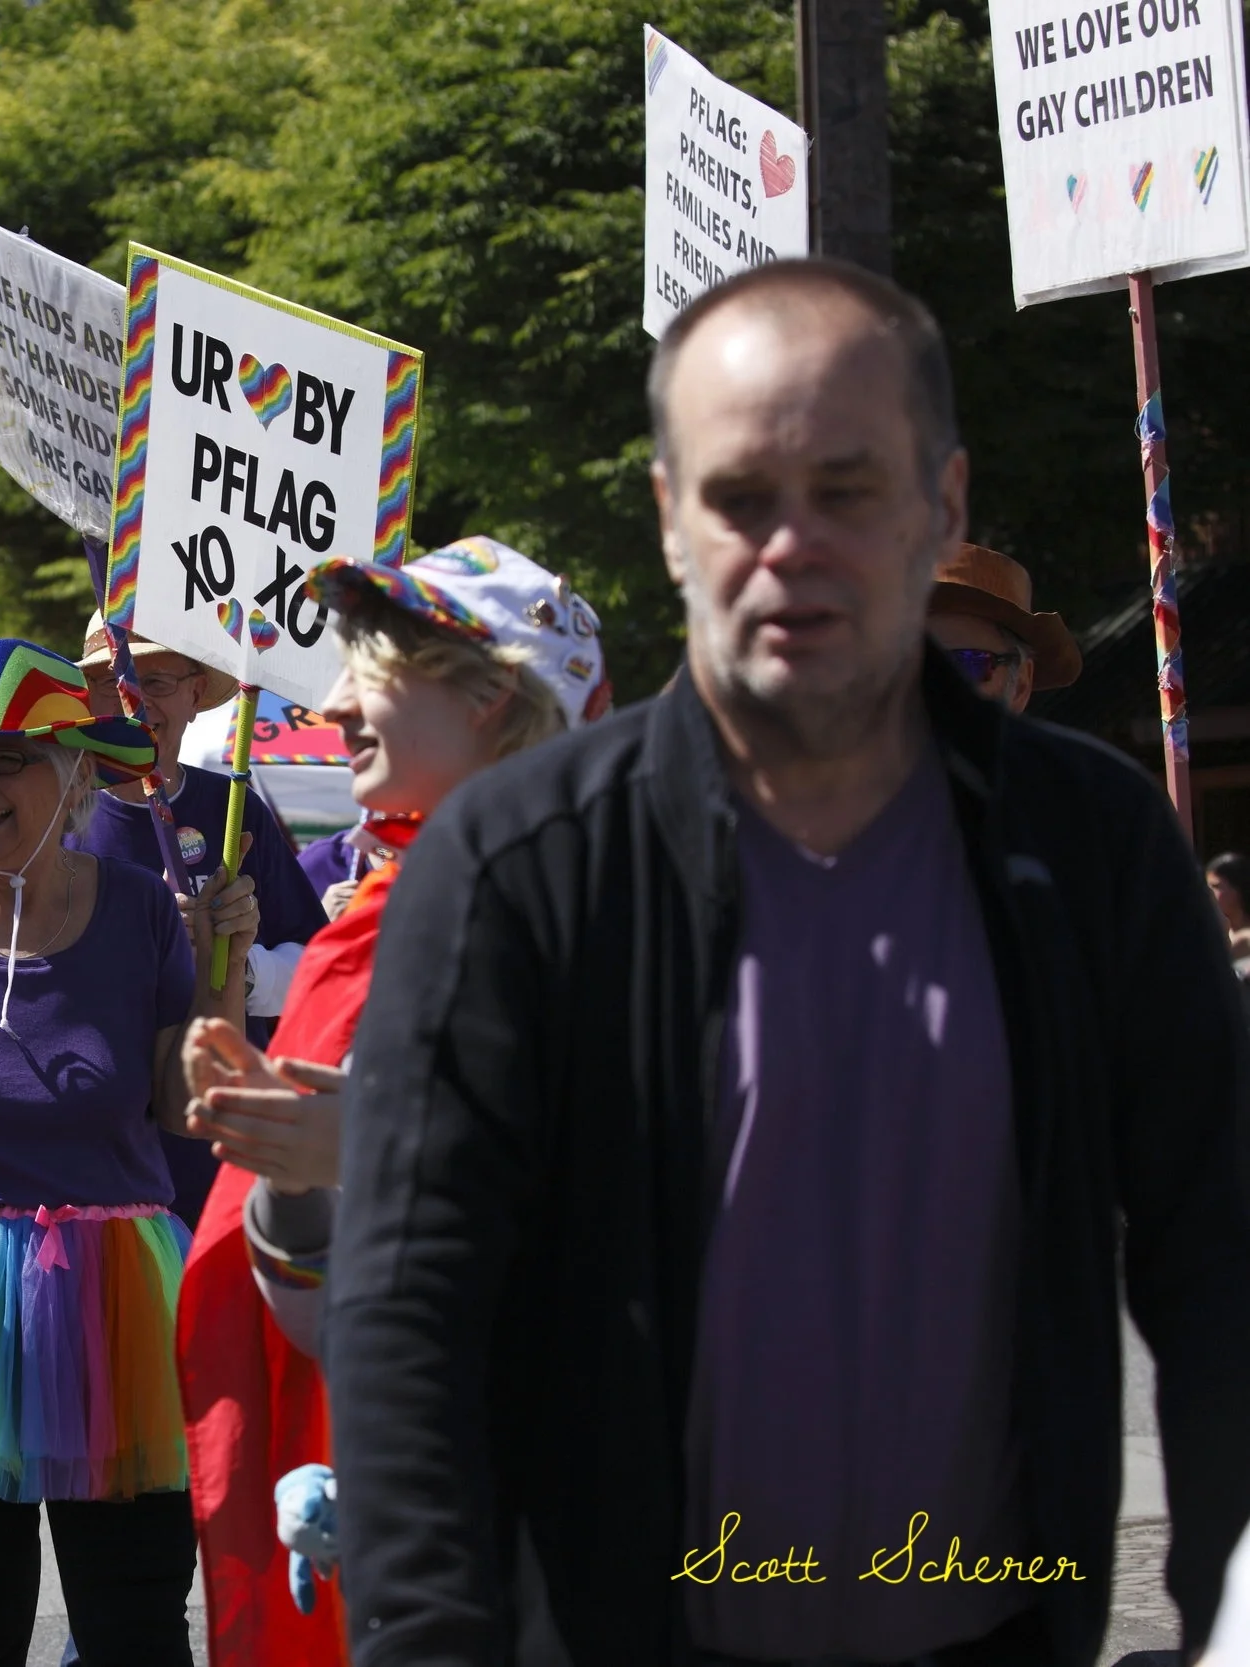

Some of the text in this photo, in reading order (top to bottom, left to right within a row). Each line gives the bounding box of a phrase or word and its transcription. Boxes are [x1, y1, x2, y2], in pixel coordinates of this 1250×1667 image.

[1015, 0, 1201, 70] WE LOVE OUR
[690, 87, 747, 155] PFLAG:
[1017, 55, 1213, 142] GAY CHILDREN
[680, 131, 757, 218] PARENTS,
[666, 171, 732, 250] FAMILIES
[674, 229, 735, 290] FRIEND
[18, 288, 77, 344] KIDS
[1, 369, 65, 434] SOME
[171, 323, 356, 456] UR BY
[28, 435, 71, 483] ARE
[191, 433, 337, 553] PFLAG
[171, 526, 329, 648] XO XO
[181, 847, 201, 859] DAD
